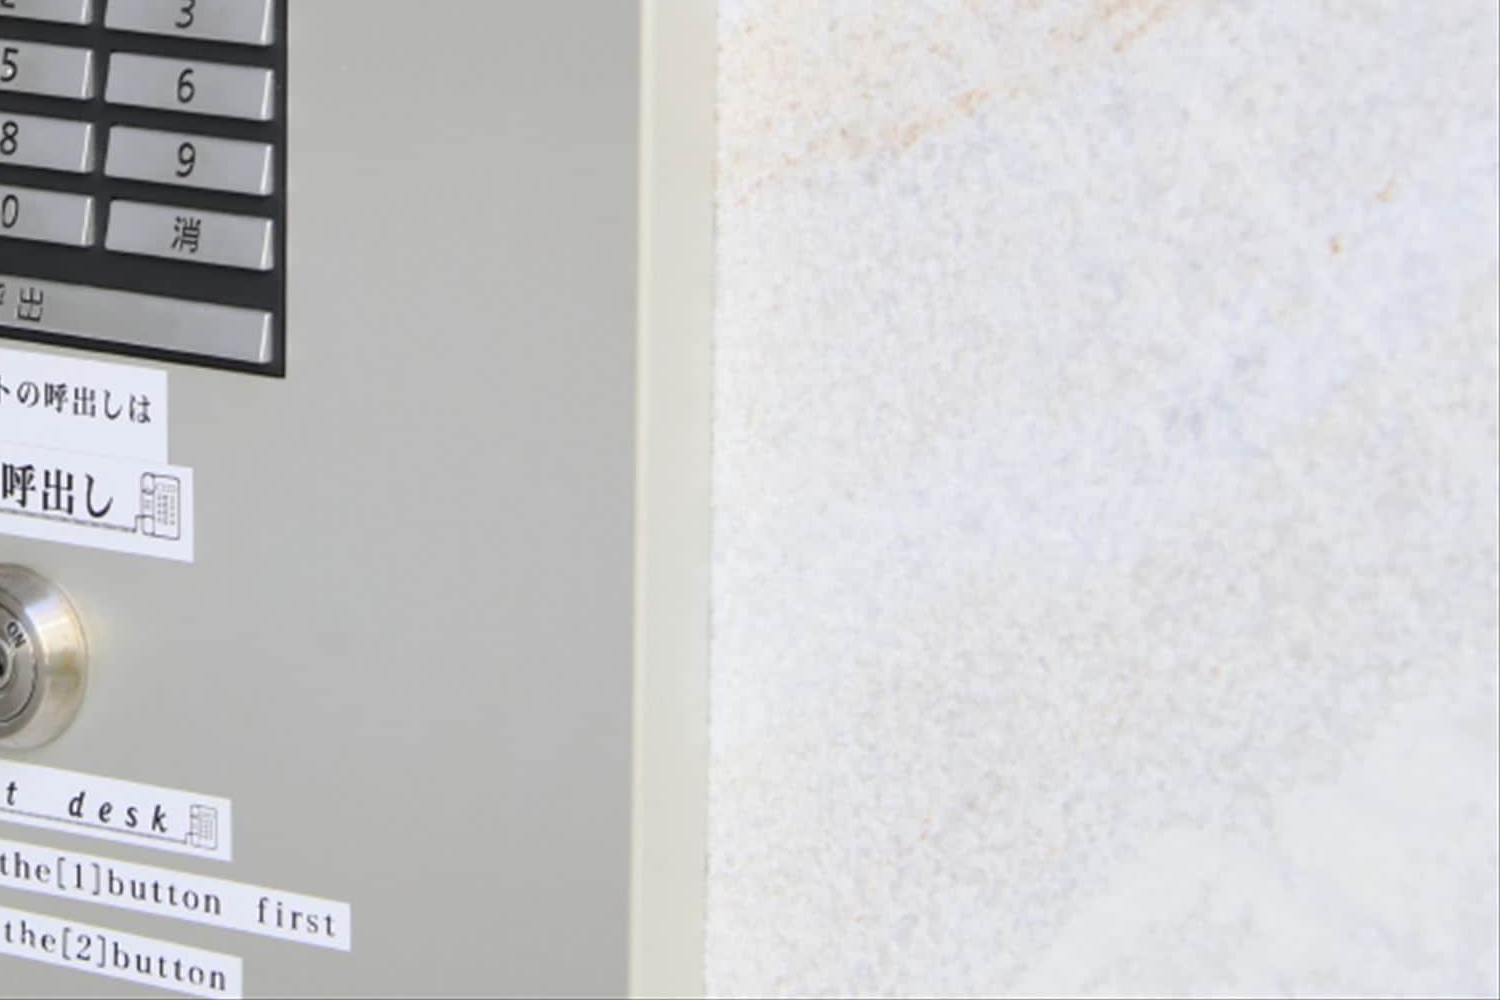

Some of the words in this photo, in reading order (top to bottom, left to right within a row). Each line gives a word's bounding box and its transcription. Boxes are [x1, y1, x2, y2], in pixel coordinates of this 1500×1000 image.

[0, 47, 20, 83] 5
[176, 68, 196, 104] 6
[0, 120, 20, 156] 8
[175, 141, 197, 178] 9
[0, 193, 20, 230] 0
[170, 215, 203, 255] 消
[6, 621, 27, 648] ON
[68, 790, 171, 834] desk
[255, 897, 338, 938] first
